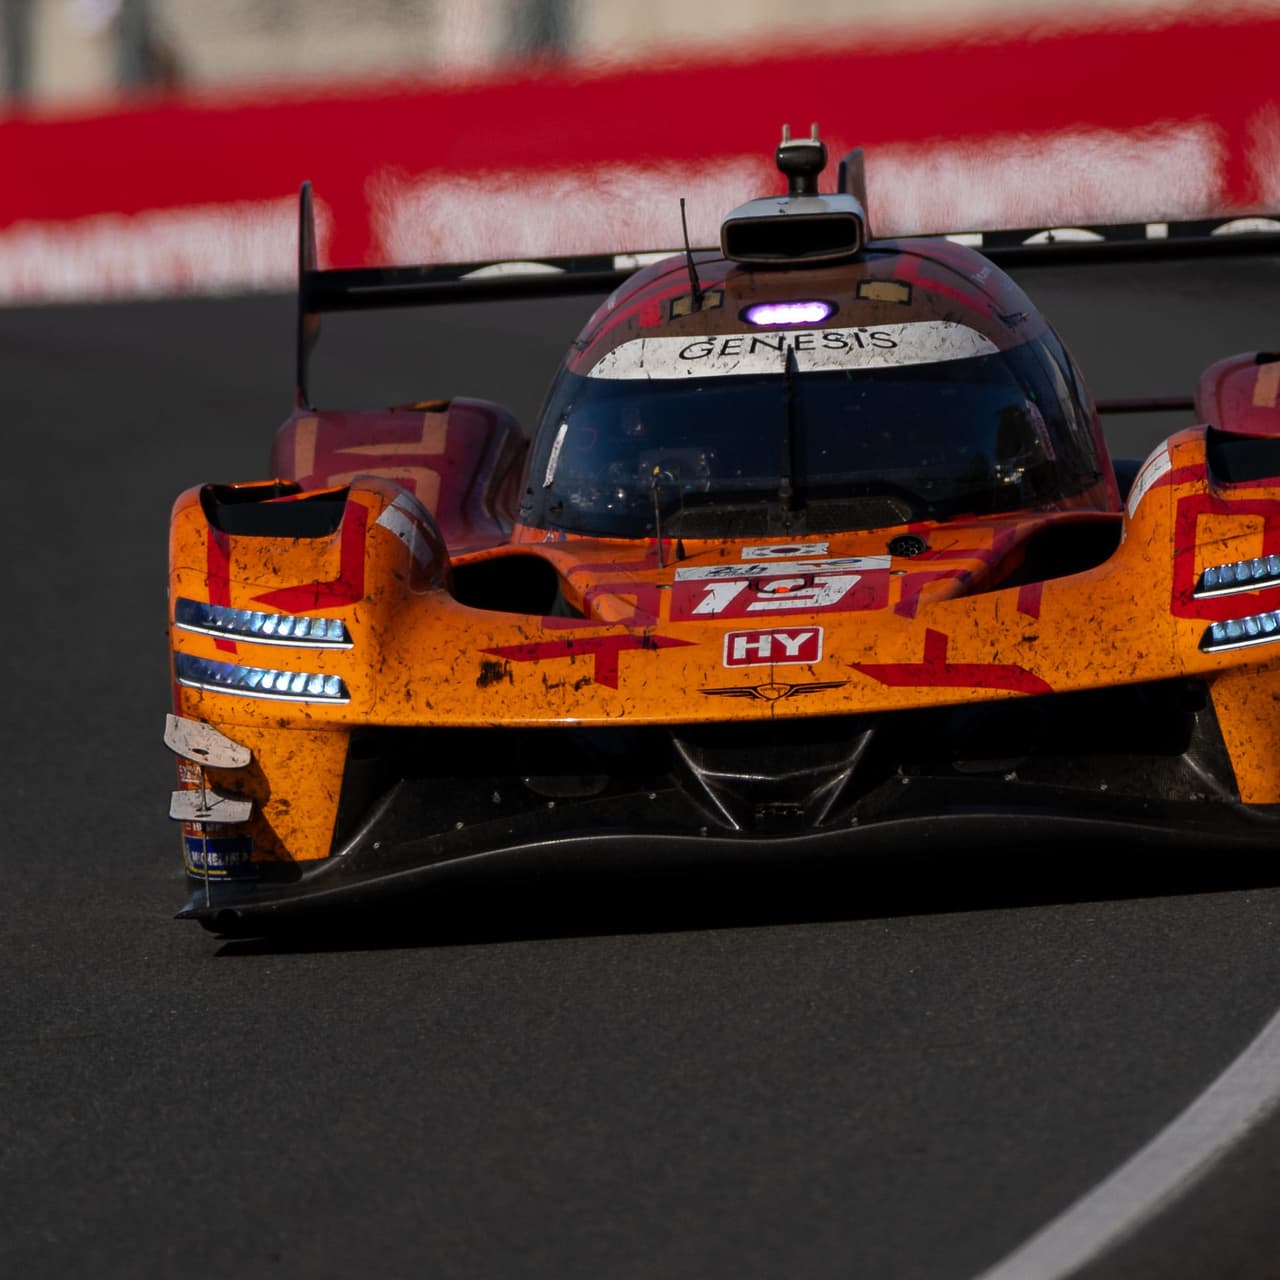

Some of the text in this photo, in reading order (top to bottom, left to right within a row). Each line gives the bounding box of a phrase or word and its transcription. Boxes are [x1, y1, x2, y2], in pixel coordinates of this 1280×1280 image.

[678, 330, 899, 361] GENESIS
[691, 574, 863, 615] 19
[732, 631, 815, 660] HY
